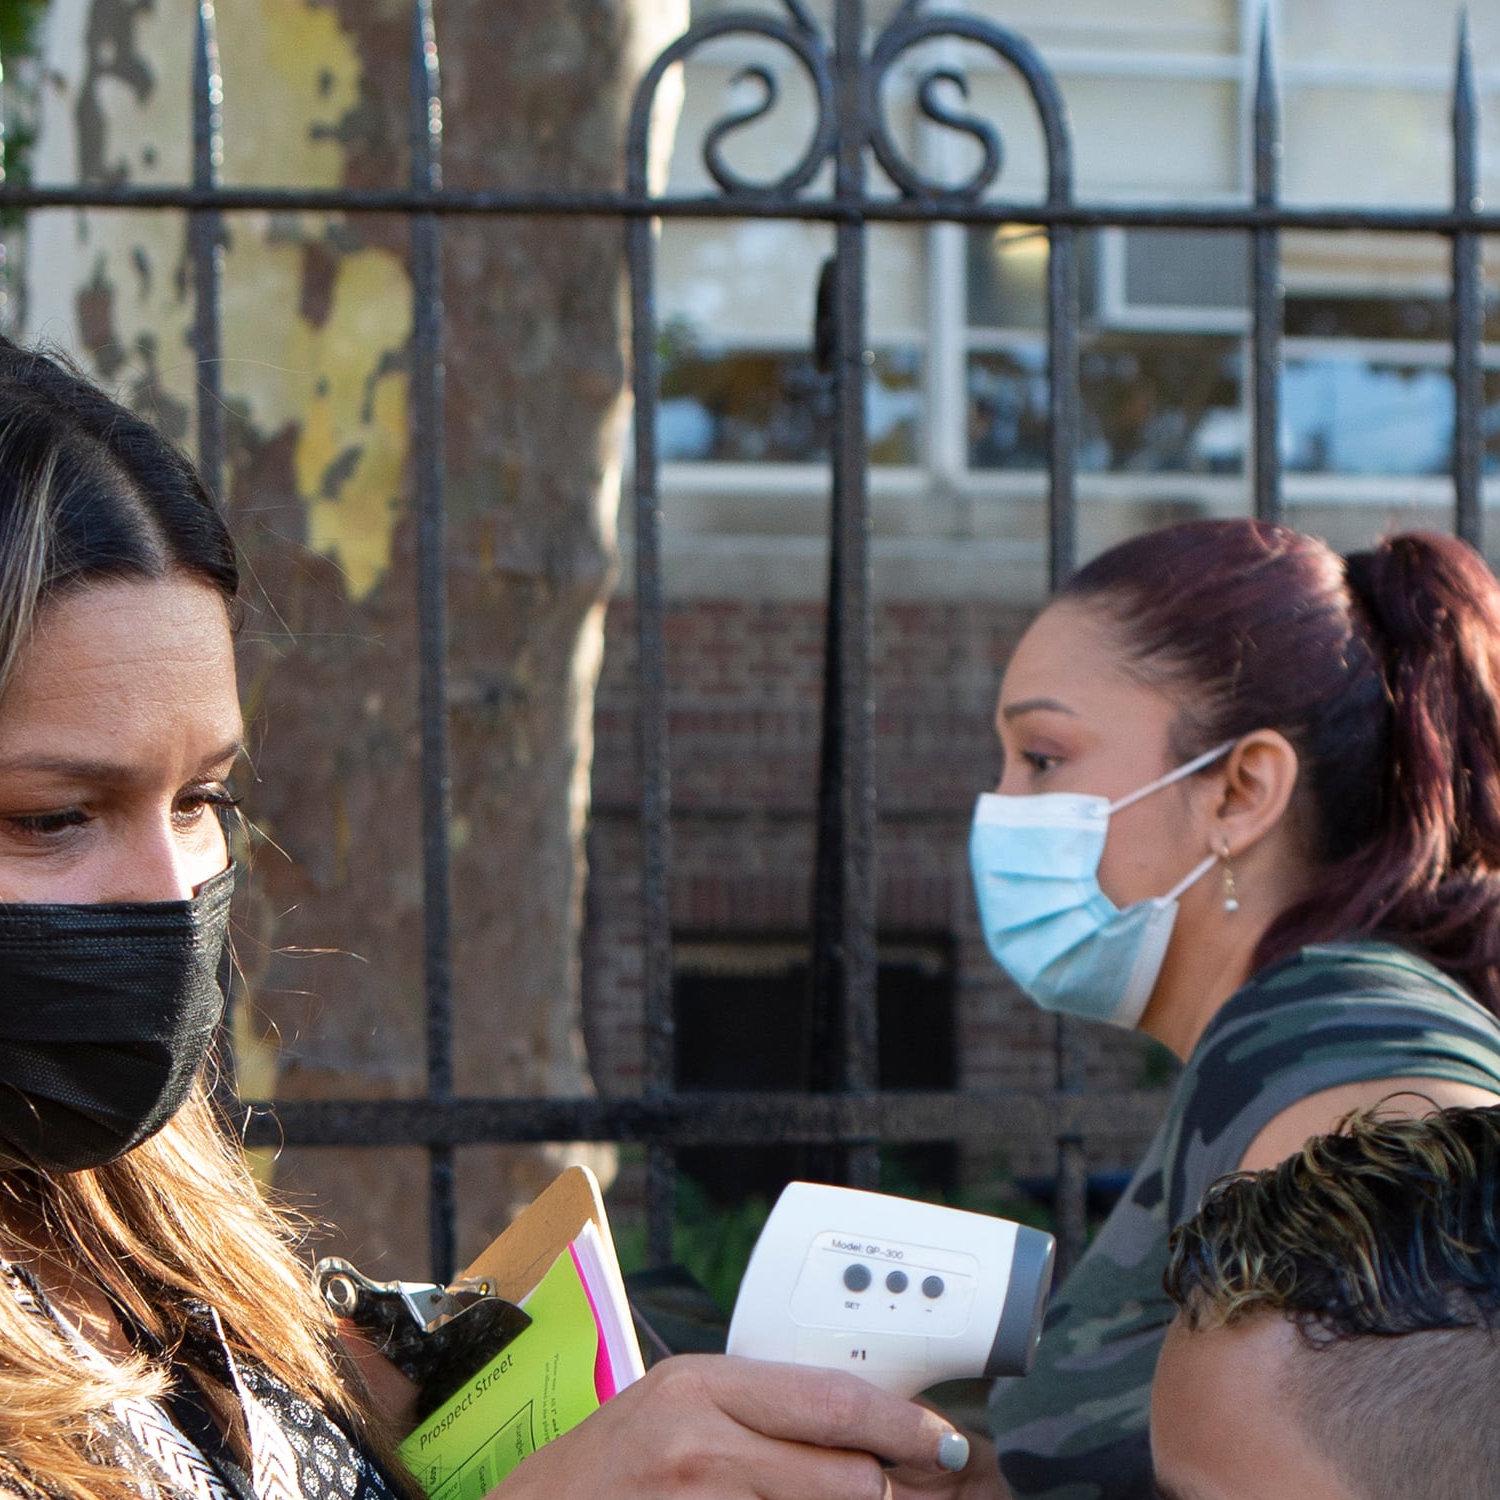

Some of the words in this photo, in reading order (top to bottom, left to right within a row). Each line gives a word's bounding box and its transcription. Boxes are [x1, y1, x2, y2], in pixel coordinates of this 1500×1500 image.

[831, 1239, 864, 1254] Model:
[844, 1300, 861, 1311] SET
[850, 1349, 867, 1361] #1
[420, 1393, 473, 1450] Prospect
[475, 1354, 515, 1399] Street
